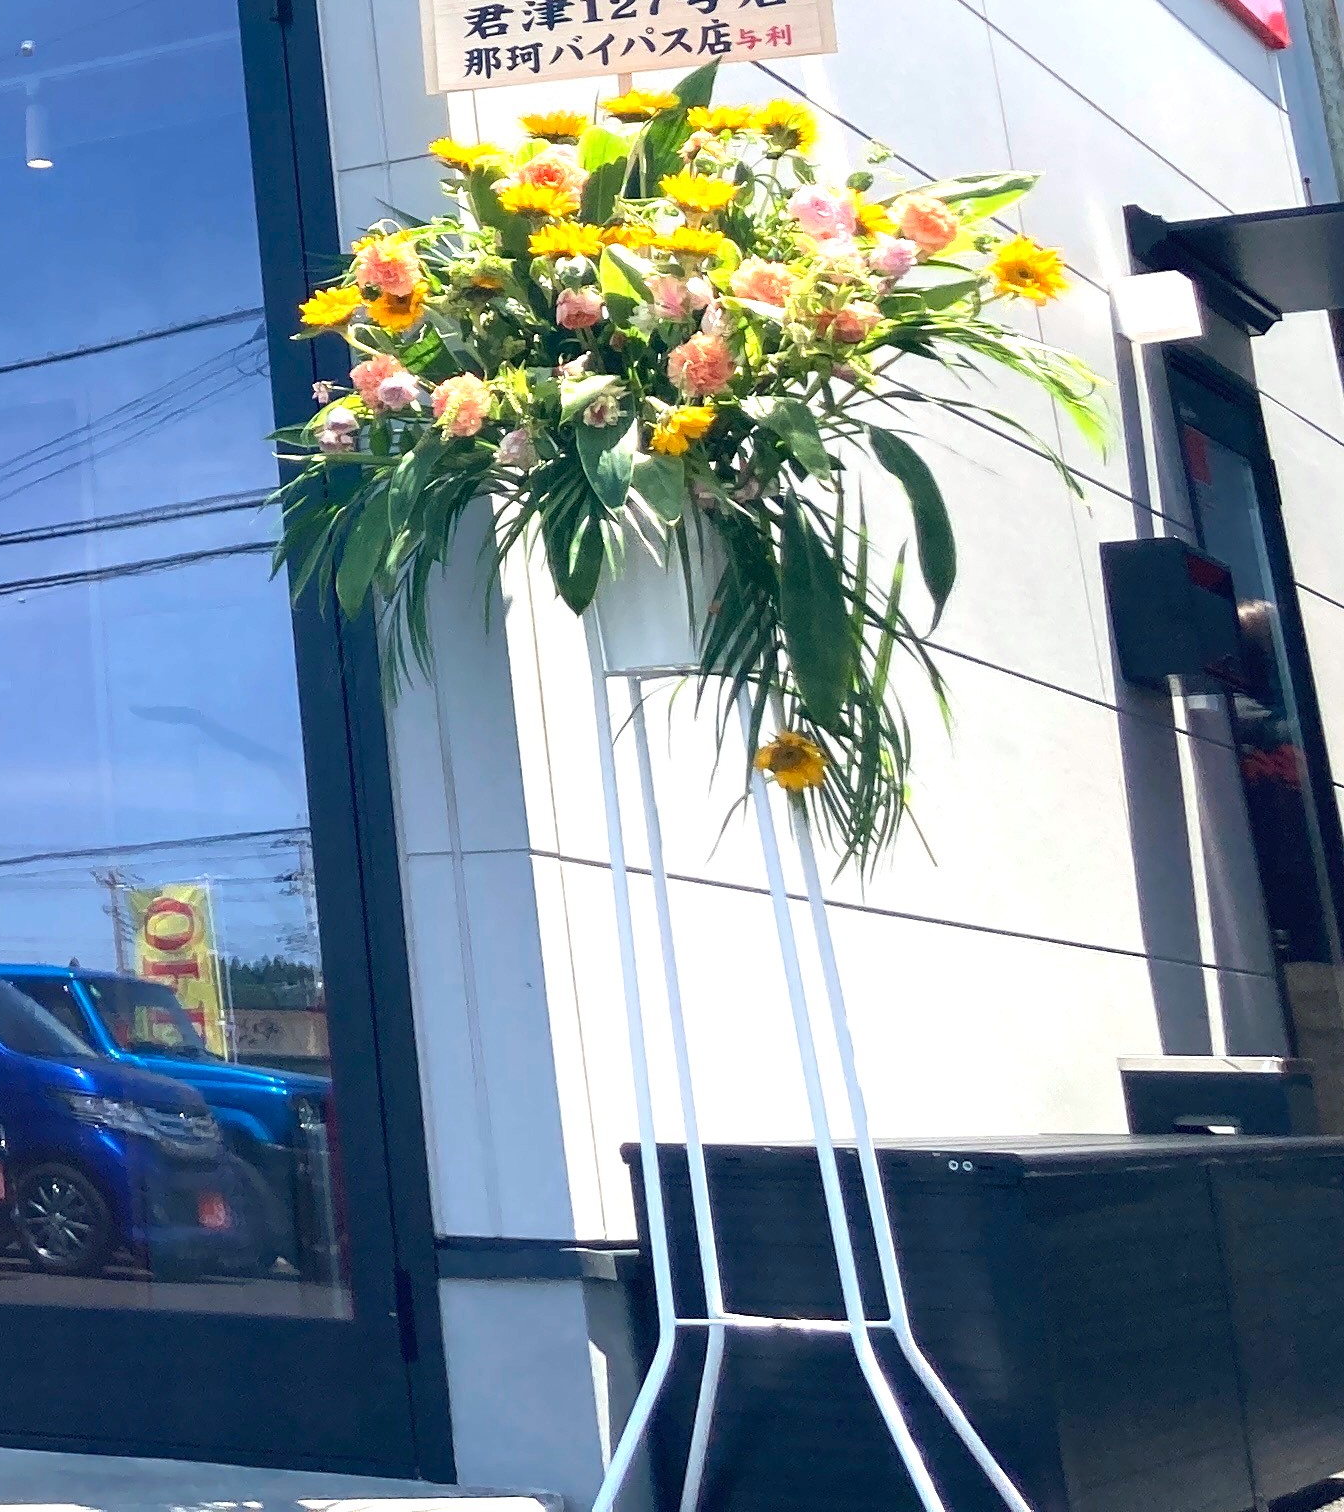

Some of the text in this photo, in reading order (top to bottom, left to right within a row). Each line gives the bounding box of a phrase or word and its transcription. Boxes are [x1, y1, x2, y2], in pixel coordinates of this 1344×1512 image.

[463, 18, 733, 80] 那珂バイパス店
